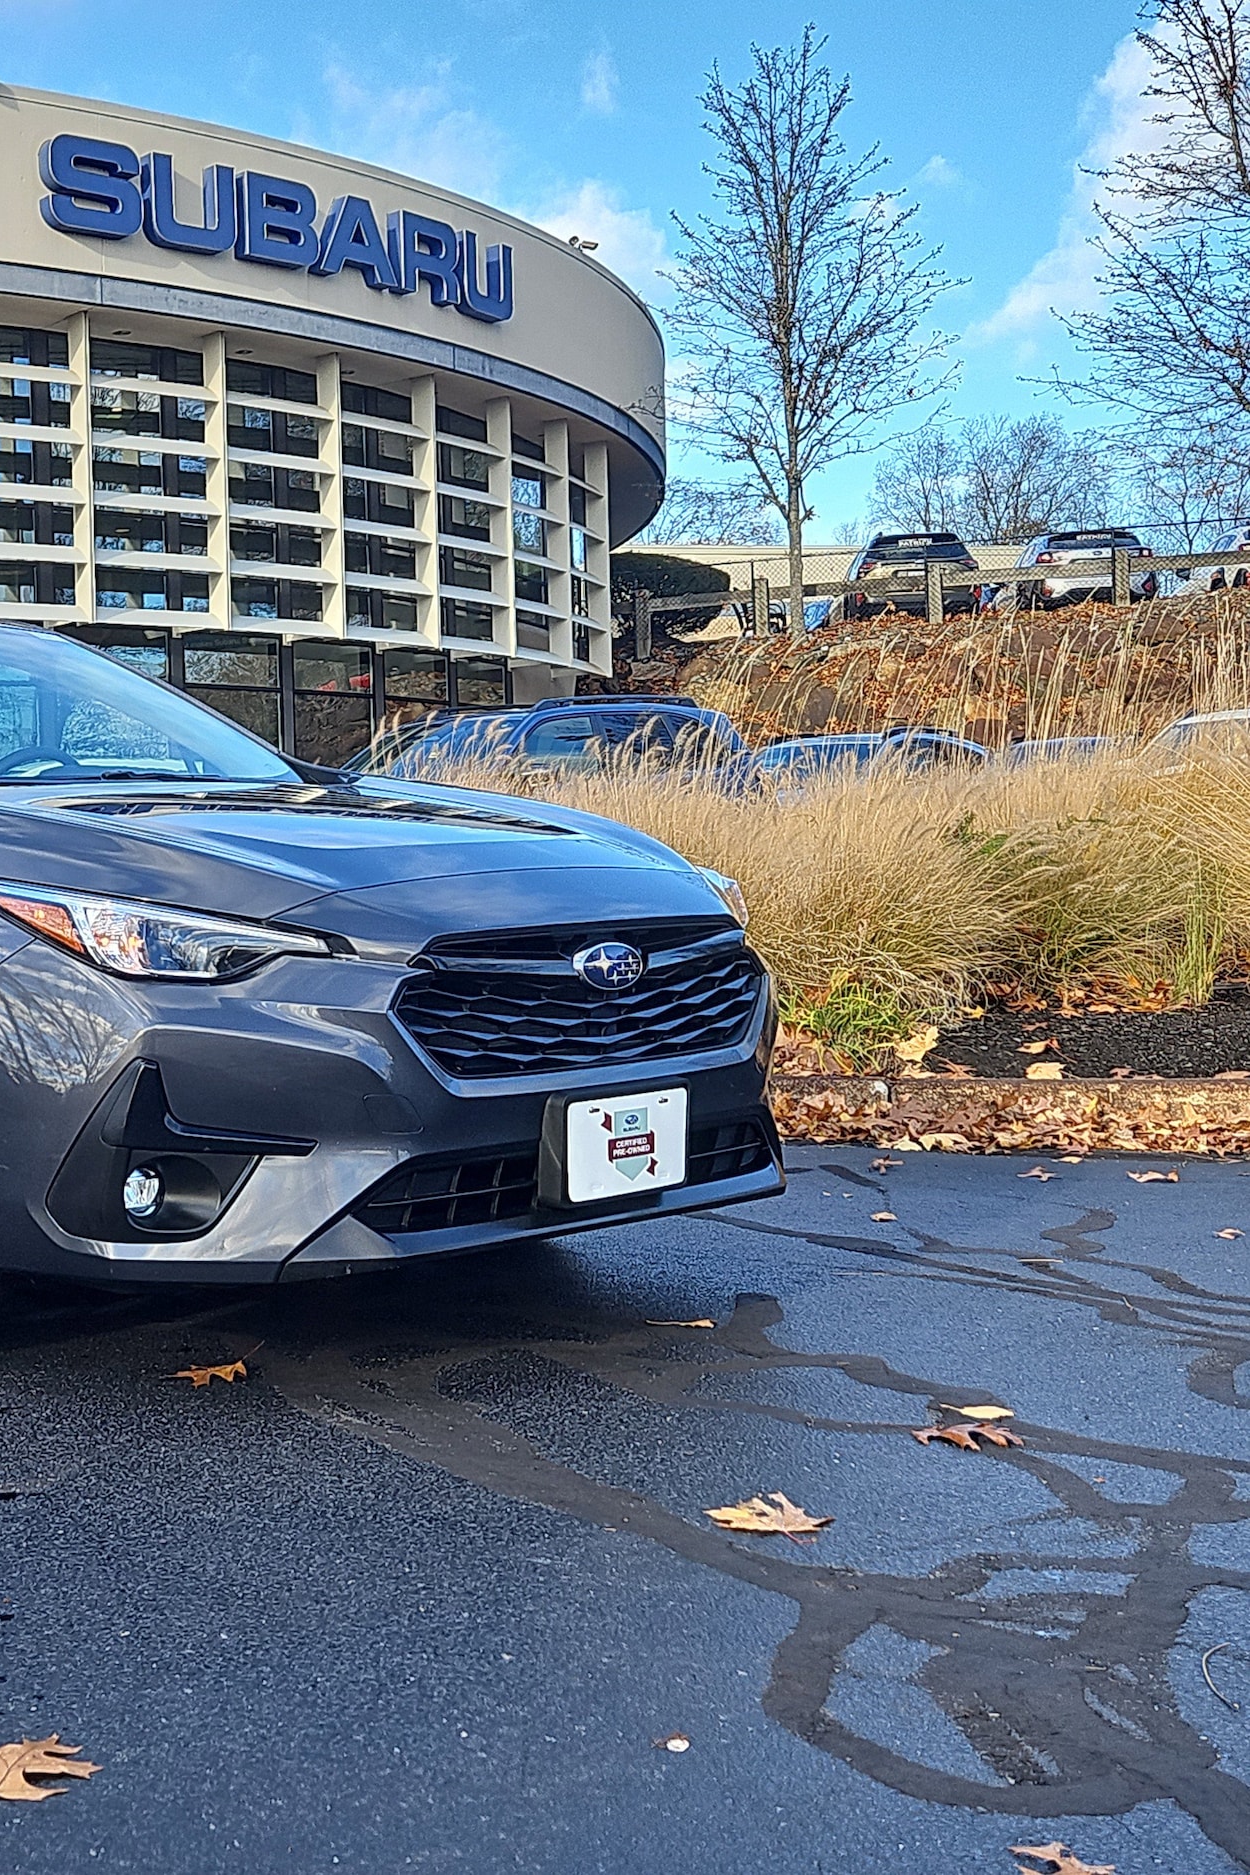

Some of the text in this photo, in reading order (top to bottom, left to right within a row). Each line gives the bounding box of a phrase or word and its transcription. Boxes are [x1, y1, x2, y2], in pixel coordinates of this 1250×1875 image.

[38, 133, 514, 323] SUBARU
[616, 1137, 648, 1148] CERTIFIED
[613, 1144, 651, 1158] PRE-OWNED
